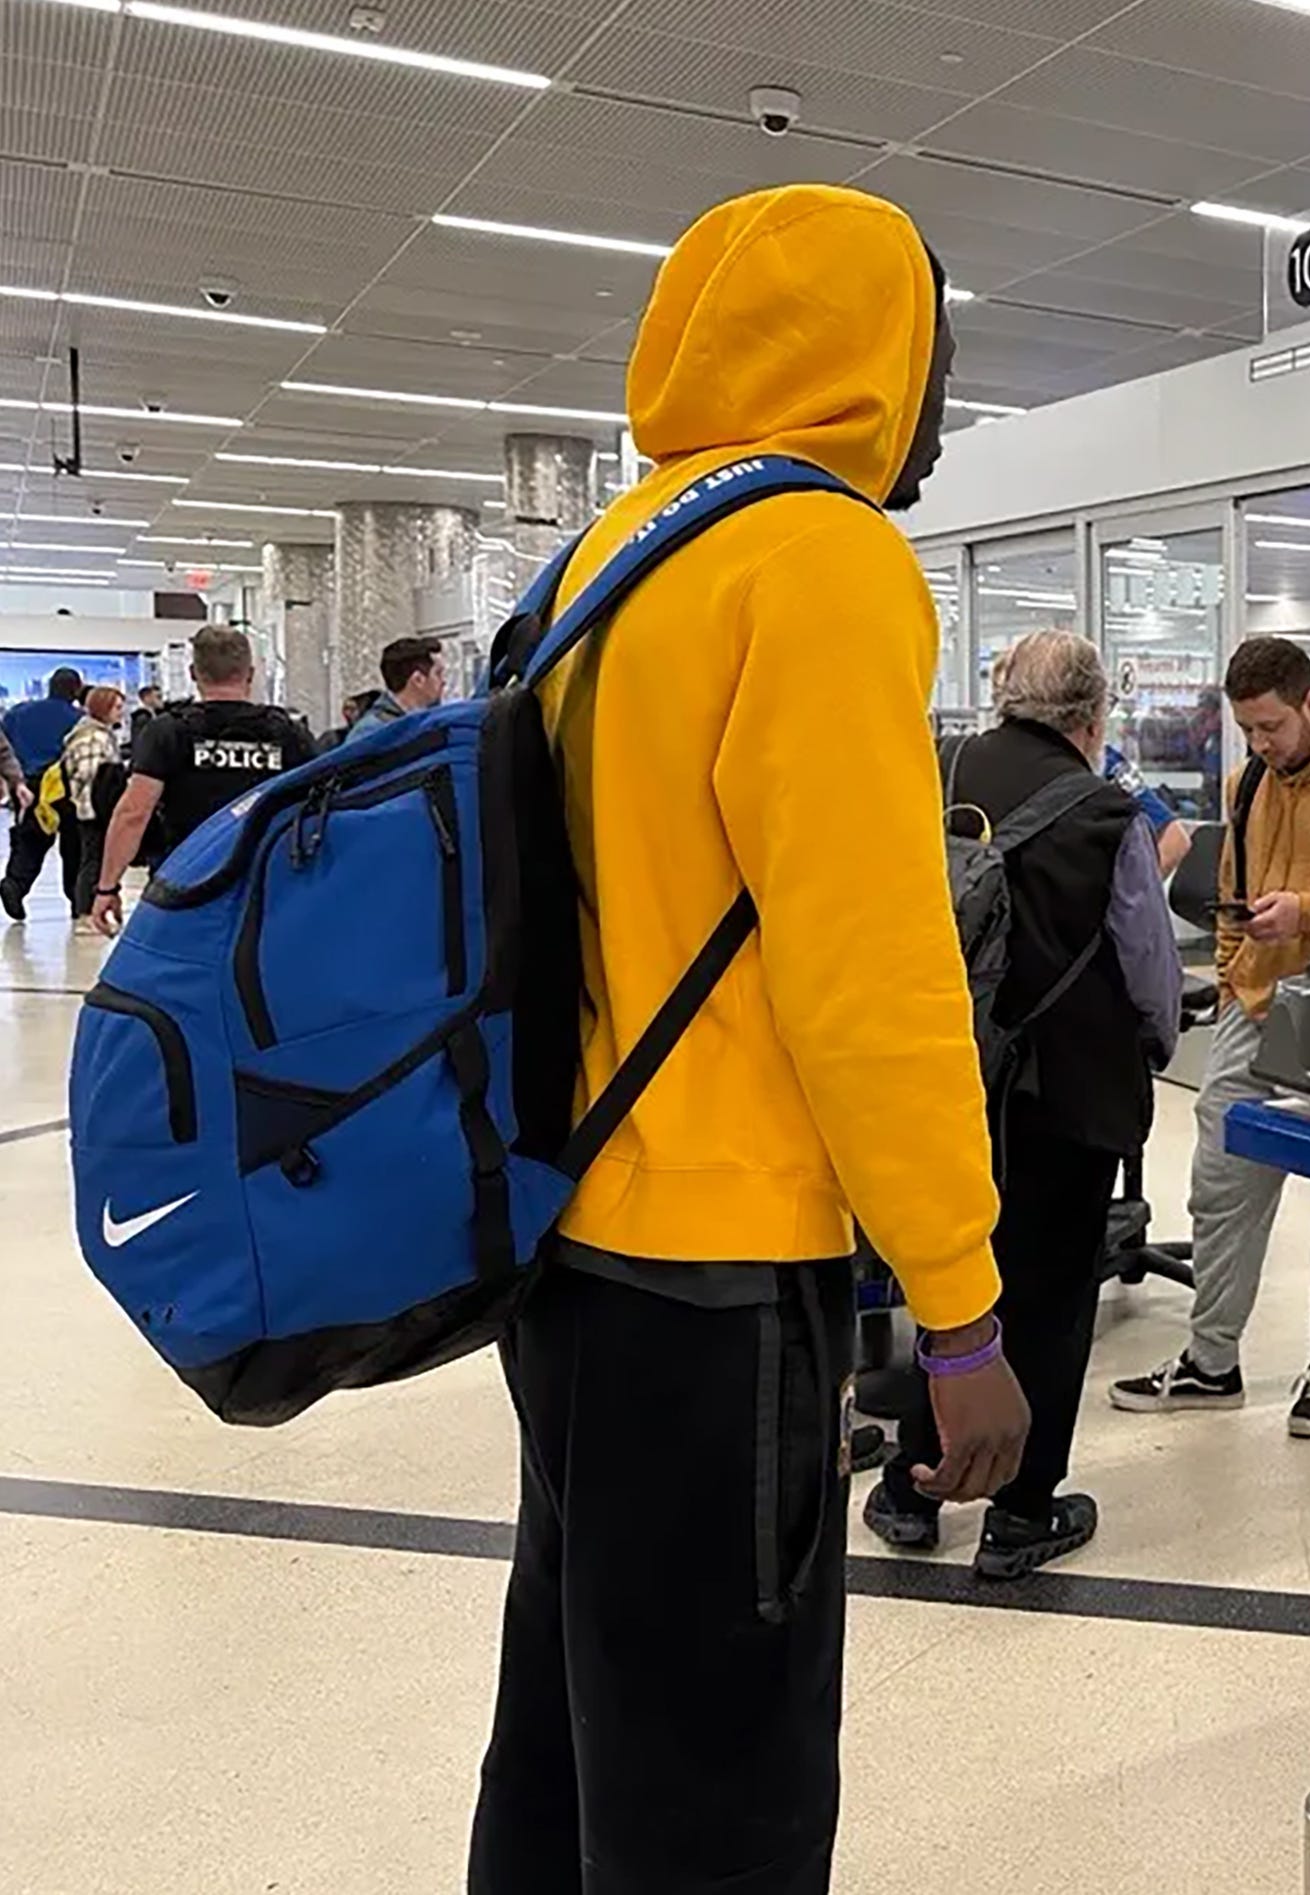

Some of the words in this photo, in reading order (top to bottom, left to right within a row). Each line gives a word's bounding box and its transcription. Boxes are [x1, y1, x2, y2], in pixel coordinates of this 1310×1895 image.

[703, 459, 765, 490] JUST
[662, 489, 700, 517] DO
[194, 749, 282, 770] POLICE
